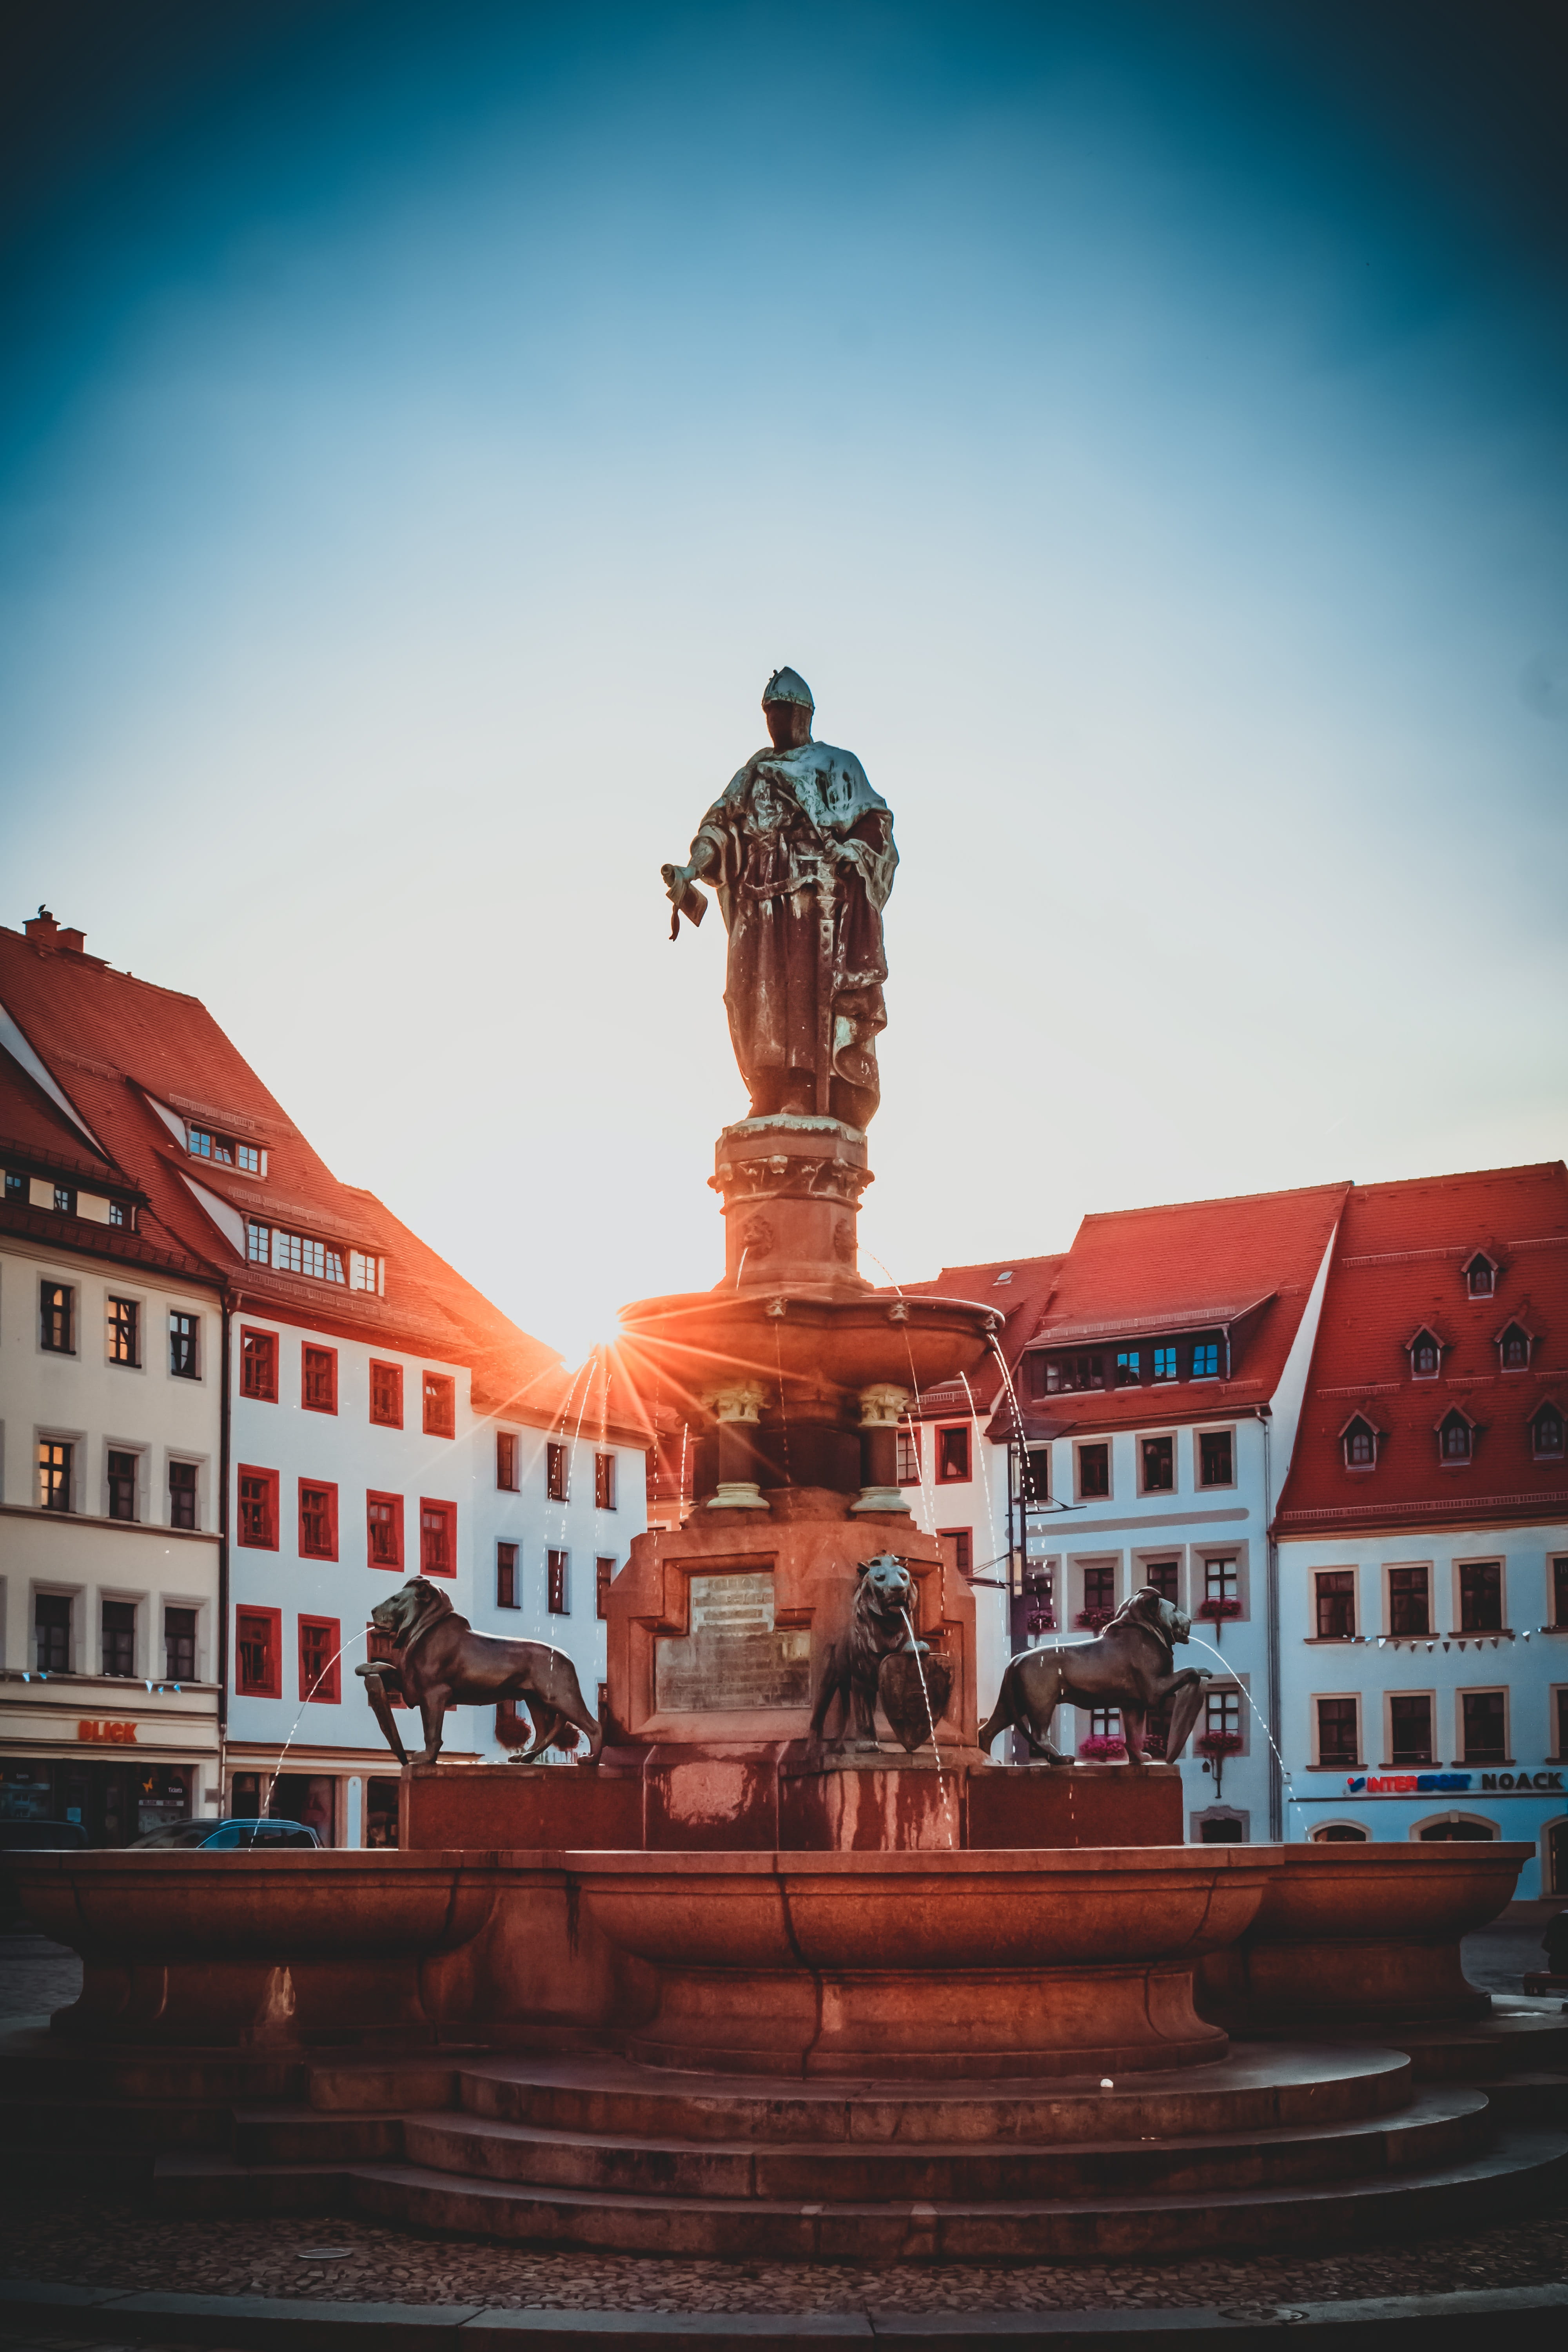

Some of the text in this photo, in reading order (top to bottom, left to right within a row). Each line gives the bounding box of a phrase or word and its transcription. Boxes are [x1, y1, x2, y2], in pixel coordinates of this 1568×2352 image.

[78, 1720, 138, 1742] BLICK
[1367, 1772, 1563, 1792] INTERSPORT NOACK
